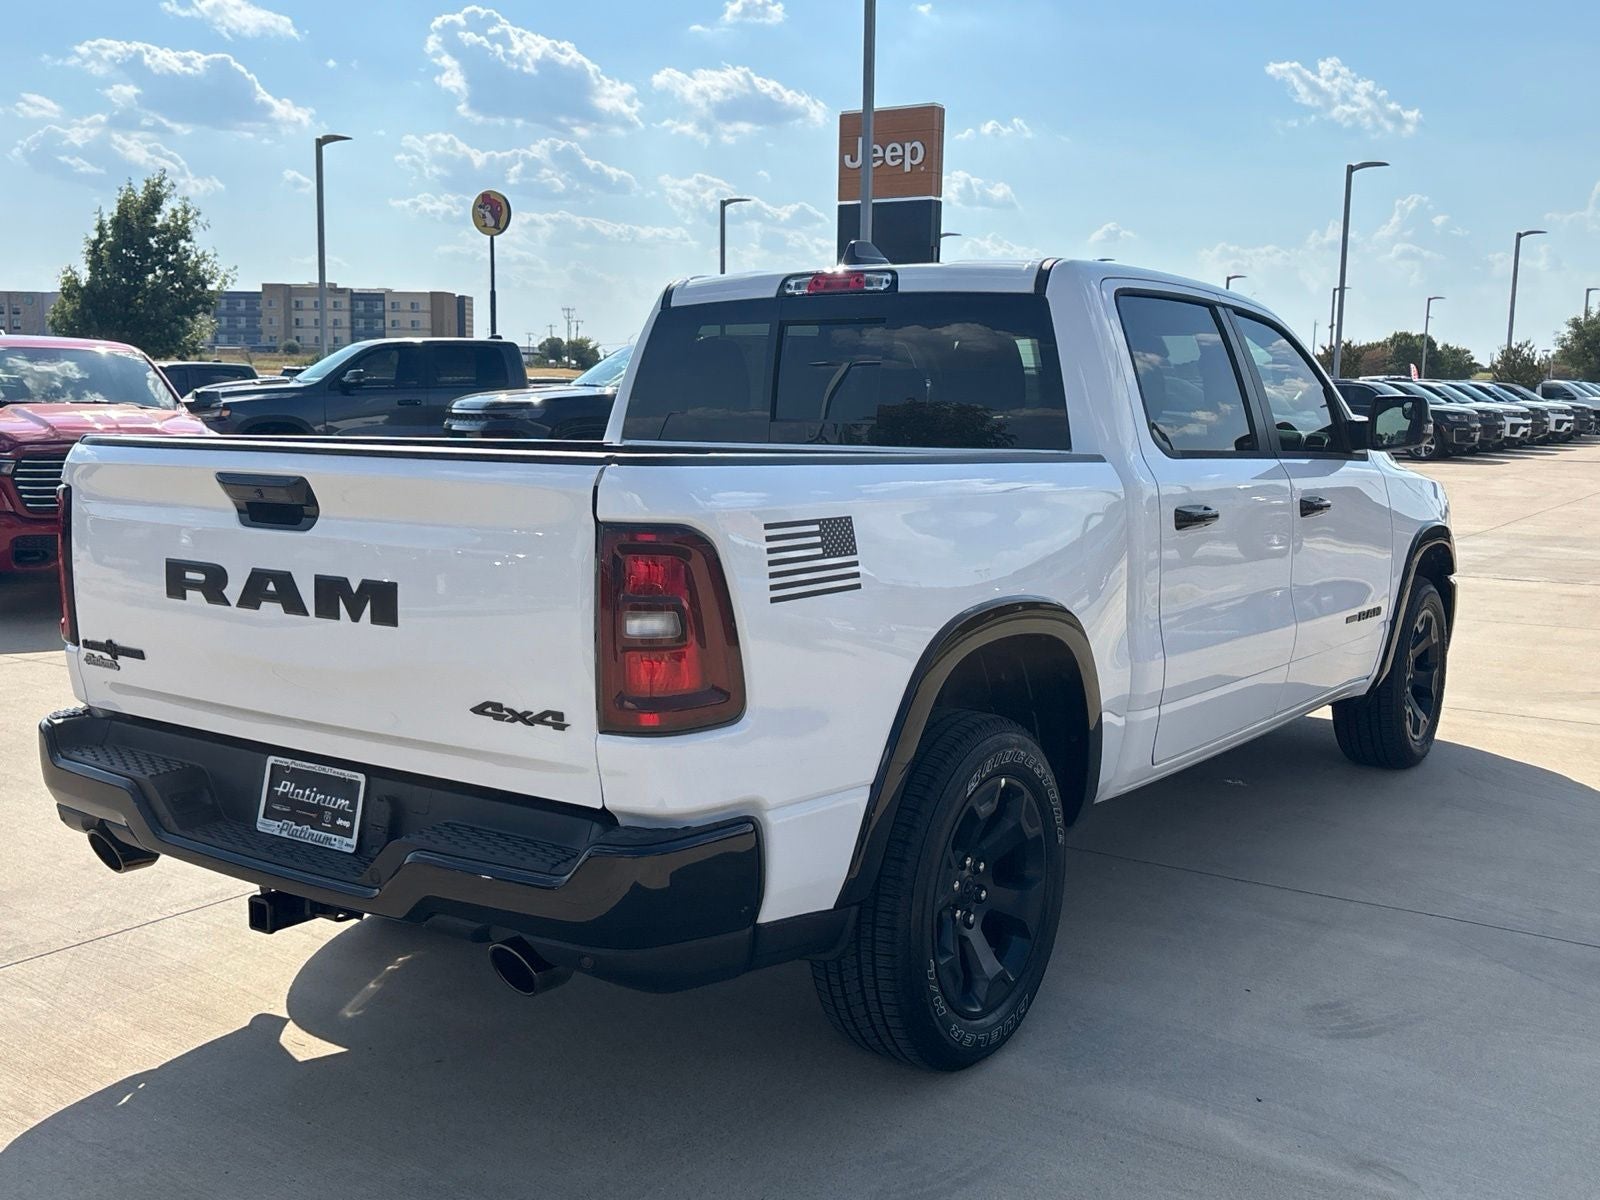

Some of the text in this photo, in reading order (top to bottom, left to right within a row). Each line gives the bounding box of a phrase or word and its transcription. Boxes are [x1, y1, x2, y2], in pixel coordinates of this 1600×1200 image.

[844, 136, 925, 173] Jeep
[165, 558, 398, 628] RAM
[1357, 606, 1382, 622] RAM
[273, 780, 353, 812] Platinum
[966, 750, 1065, 845] BRIDGESTONE
[279, 820, 336, 847] Platinum
[336, 817, 351, 829] Jeep
[949, 993, 1030, 1047] DUELER
